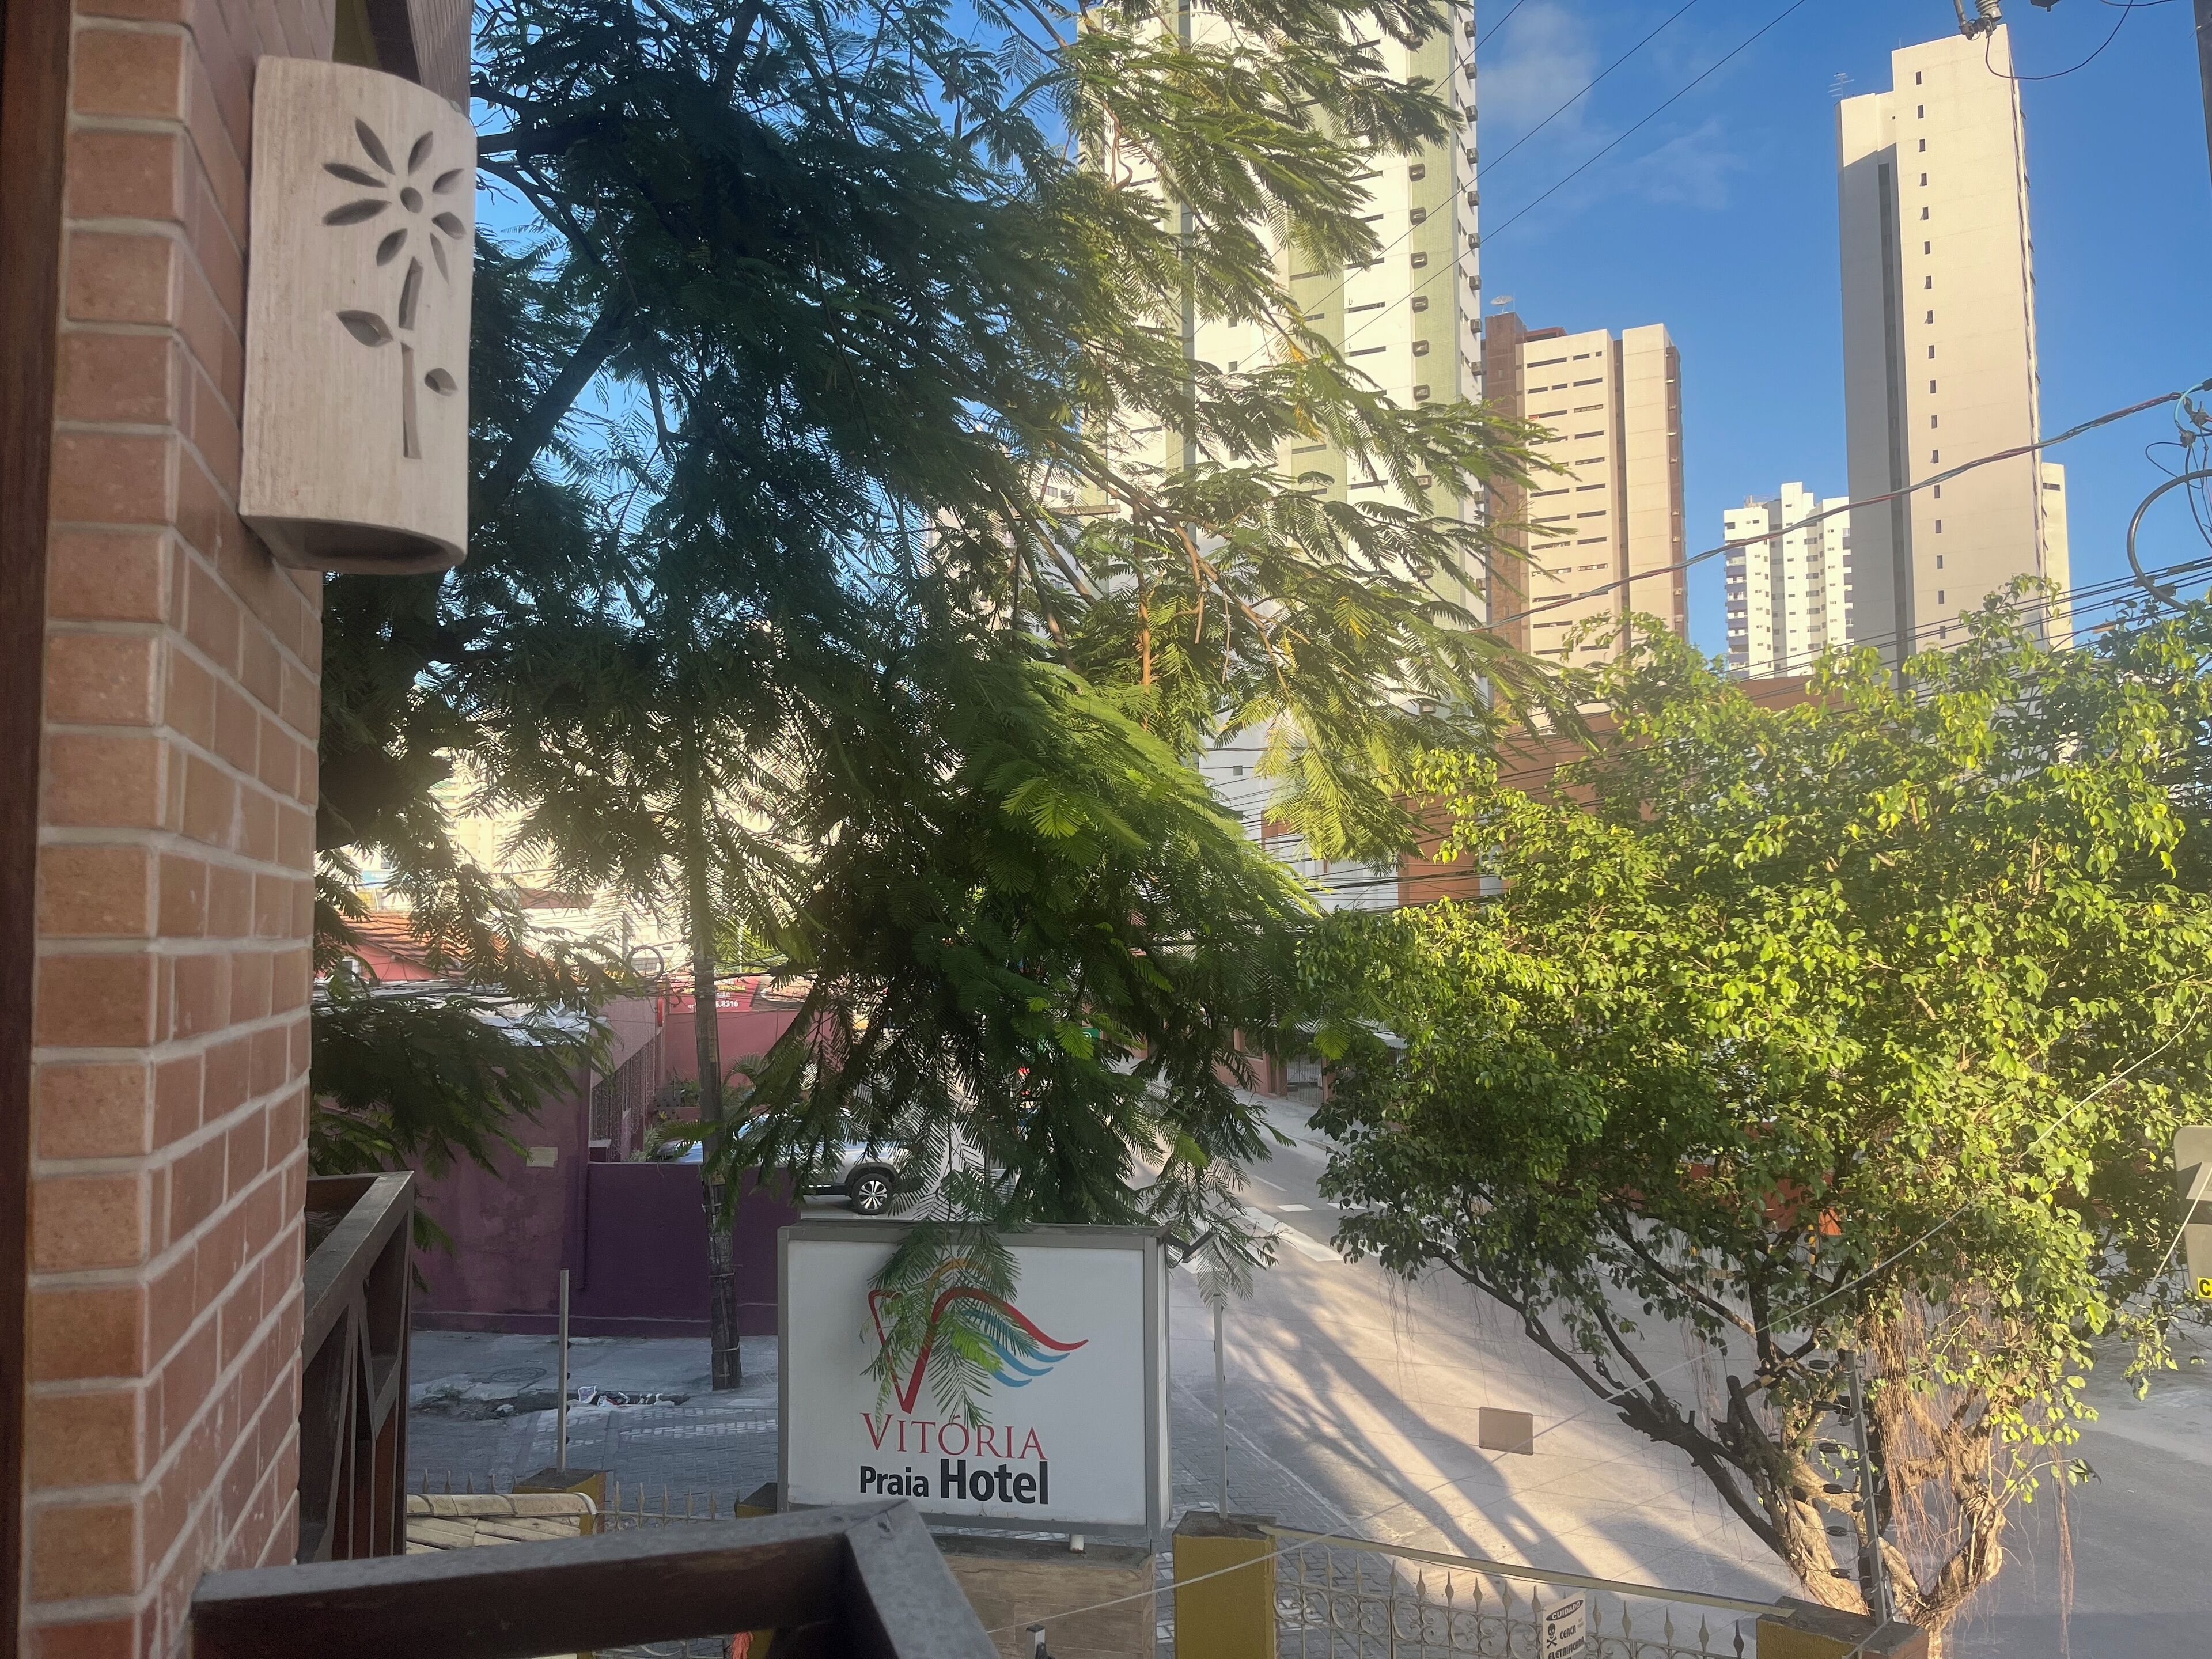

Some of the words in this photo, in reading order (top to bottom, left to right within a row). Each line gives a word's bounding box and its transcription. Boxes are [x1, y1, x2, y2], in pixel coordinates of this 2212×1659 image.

[860, 1413, 1048, 1460] VITÓRIA
[860, 1466, 929, 1497] Praia
[940, 1459, 1048, 1505] Hotel
[1552, 1601, 1580, 1620] CUIDADO
